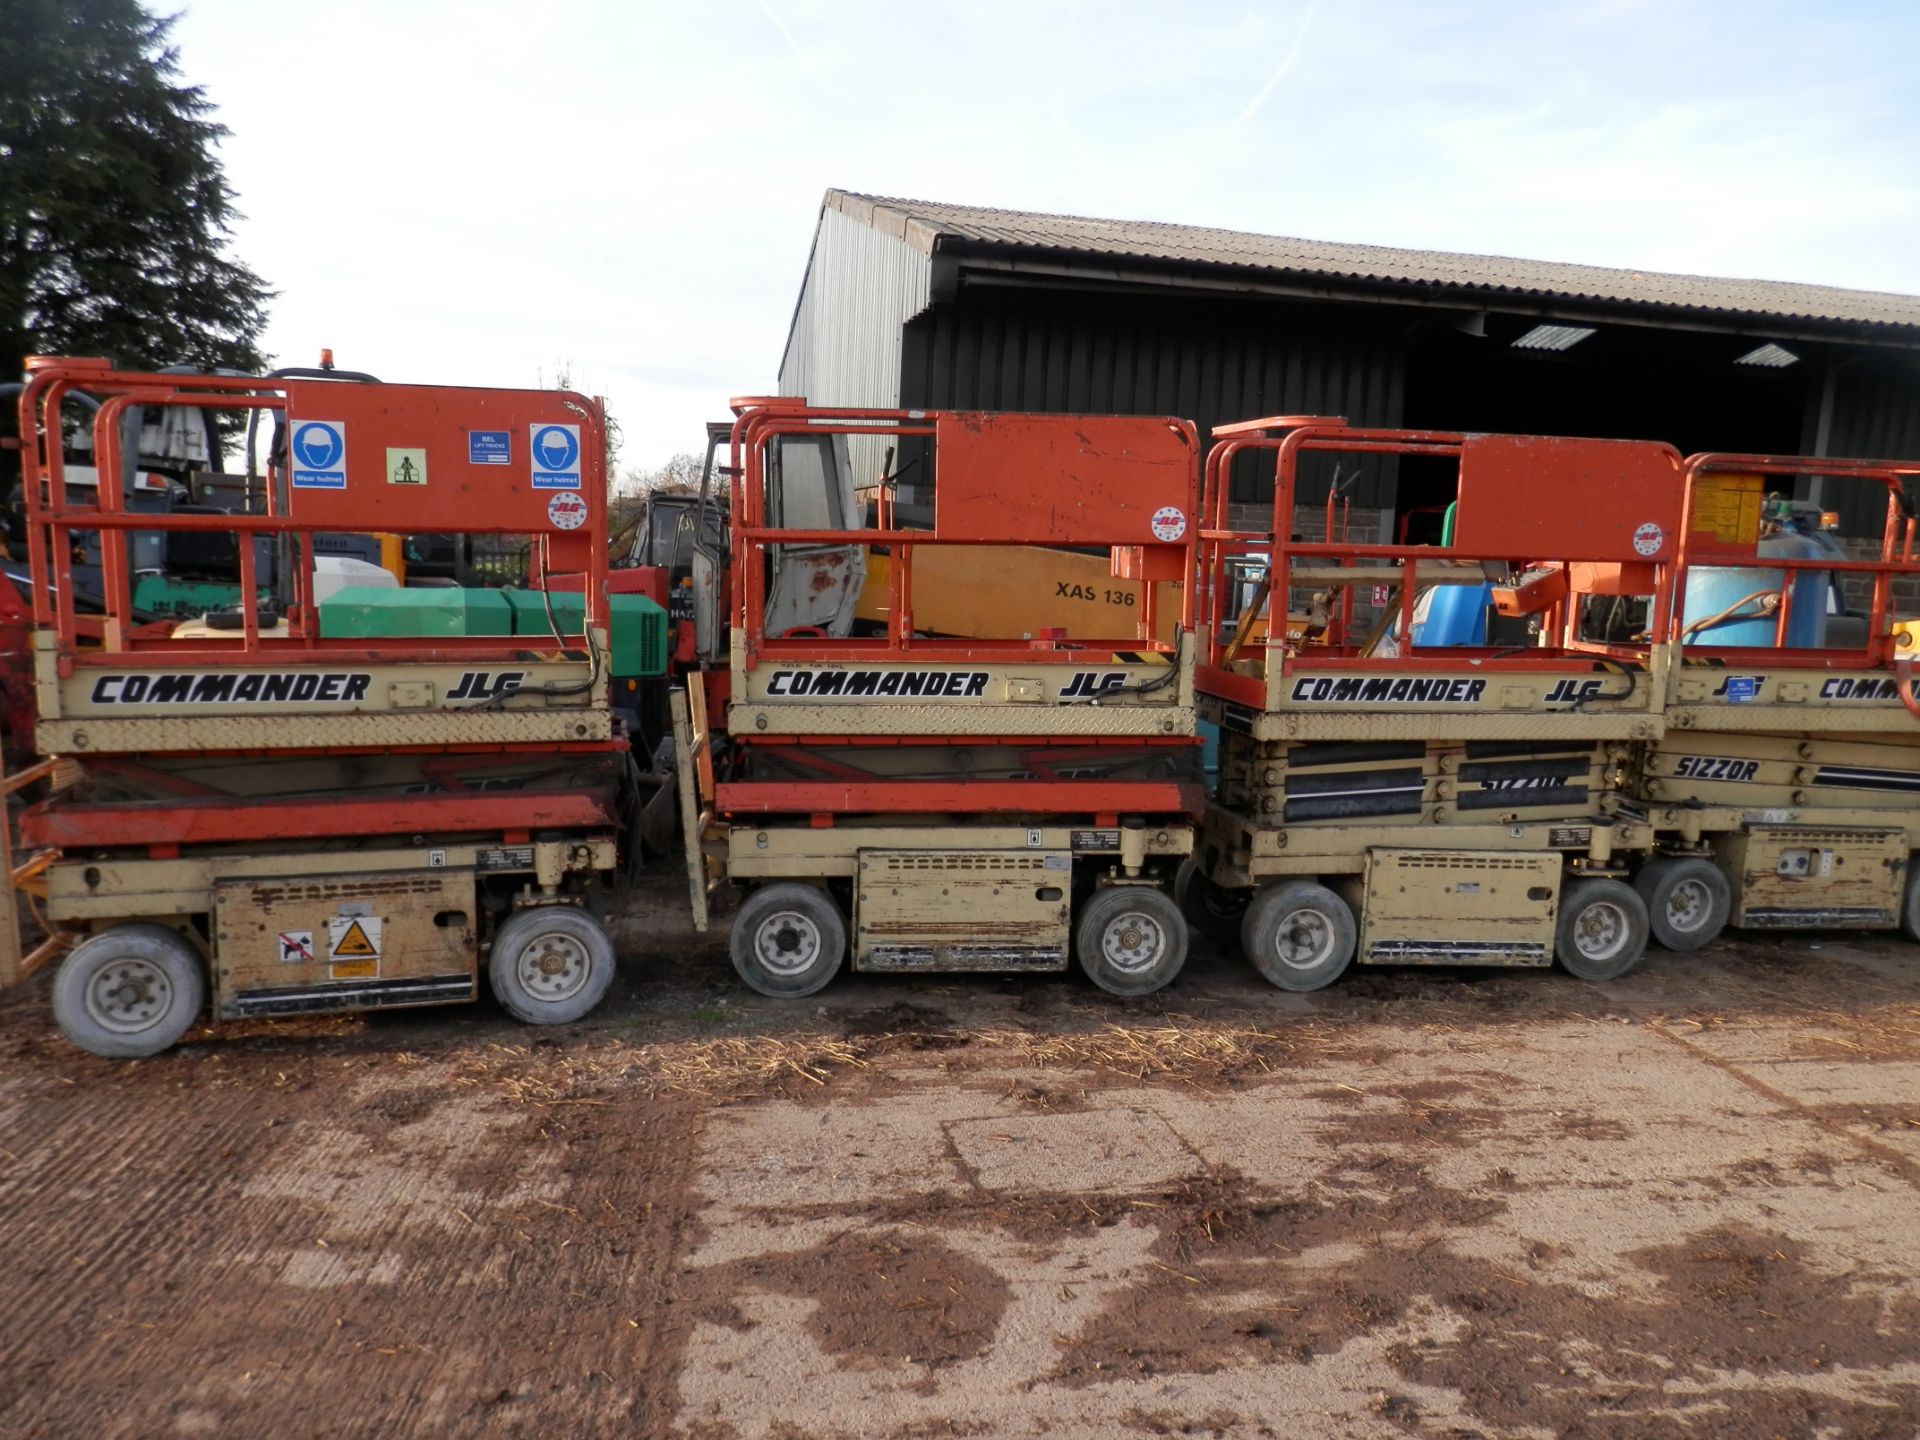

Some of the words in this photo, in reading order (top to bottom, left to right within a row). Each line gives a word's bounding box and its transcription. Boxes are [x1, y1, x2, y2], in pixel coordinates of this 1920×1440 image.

[554, 476, 578, 484] helmet
[553, 502, 581, 512] JLG
[1156, 516, 1181, 526] JLG
[1637, 531, 1659, 541] JLG
[1055, 581, 1096, 601] XAS
[1104, 590, 1135, 606] 136
[91, 673, 372, 704] COMMANDER
[446, 672, 525, 699] JLG
[766, 671, 990, 697] COMMANDER
[1058, 672, 1128, 697] JLG
[1290, 677, 1487, 702] COMMANDER
[1543, 680, 1603, 702] JLG
[1673, 756, 1761, 782] SIZZOR
